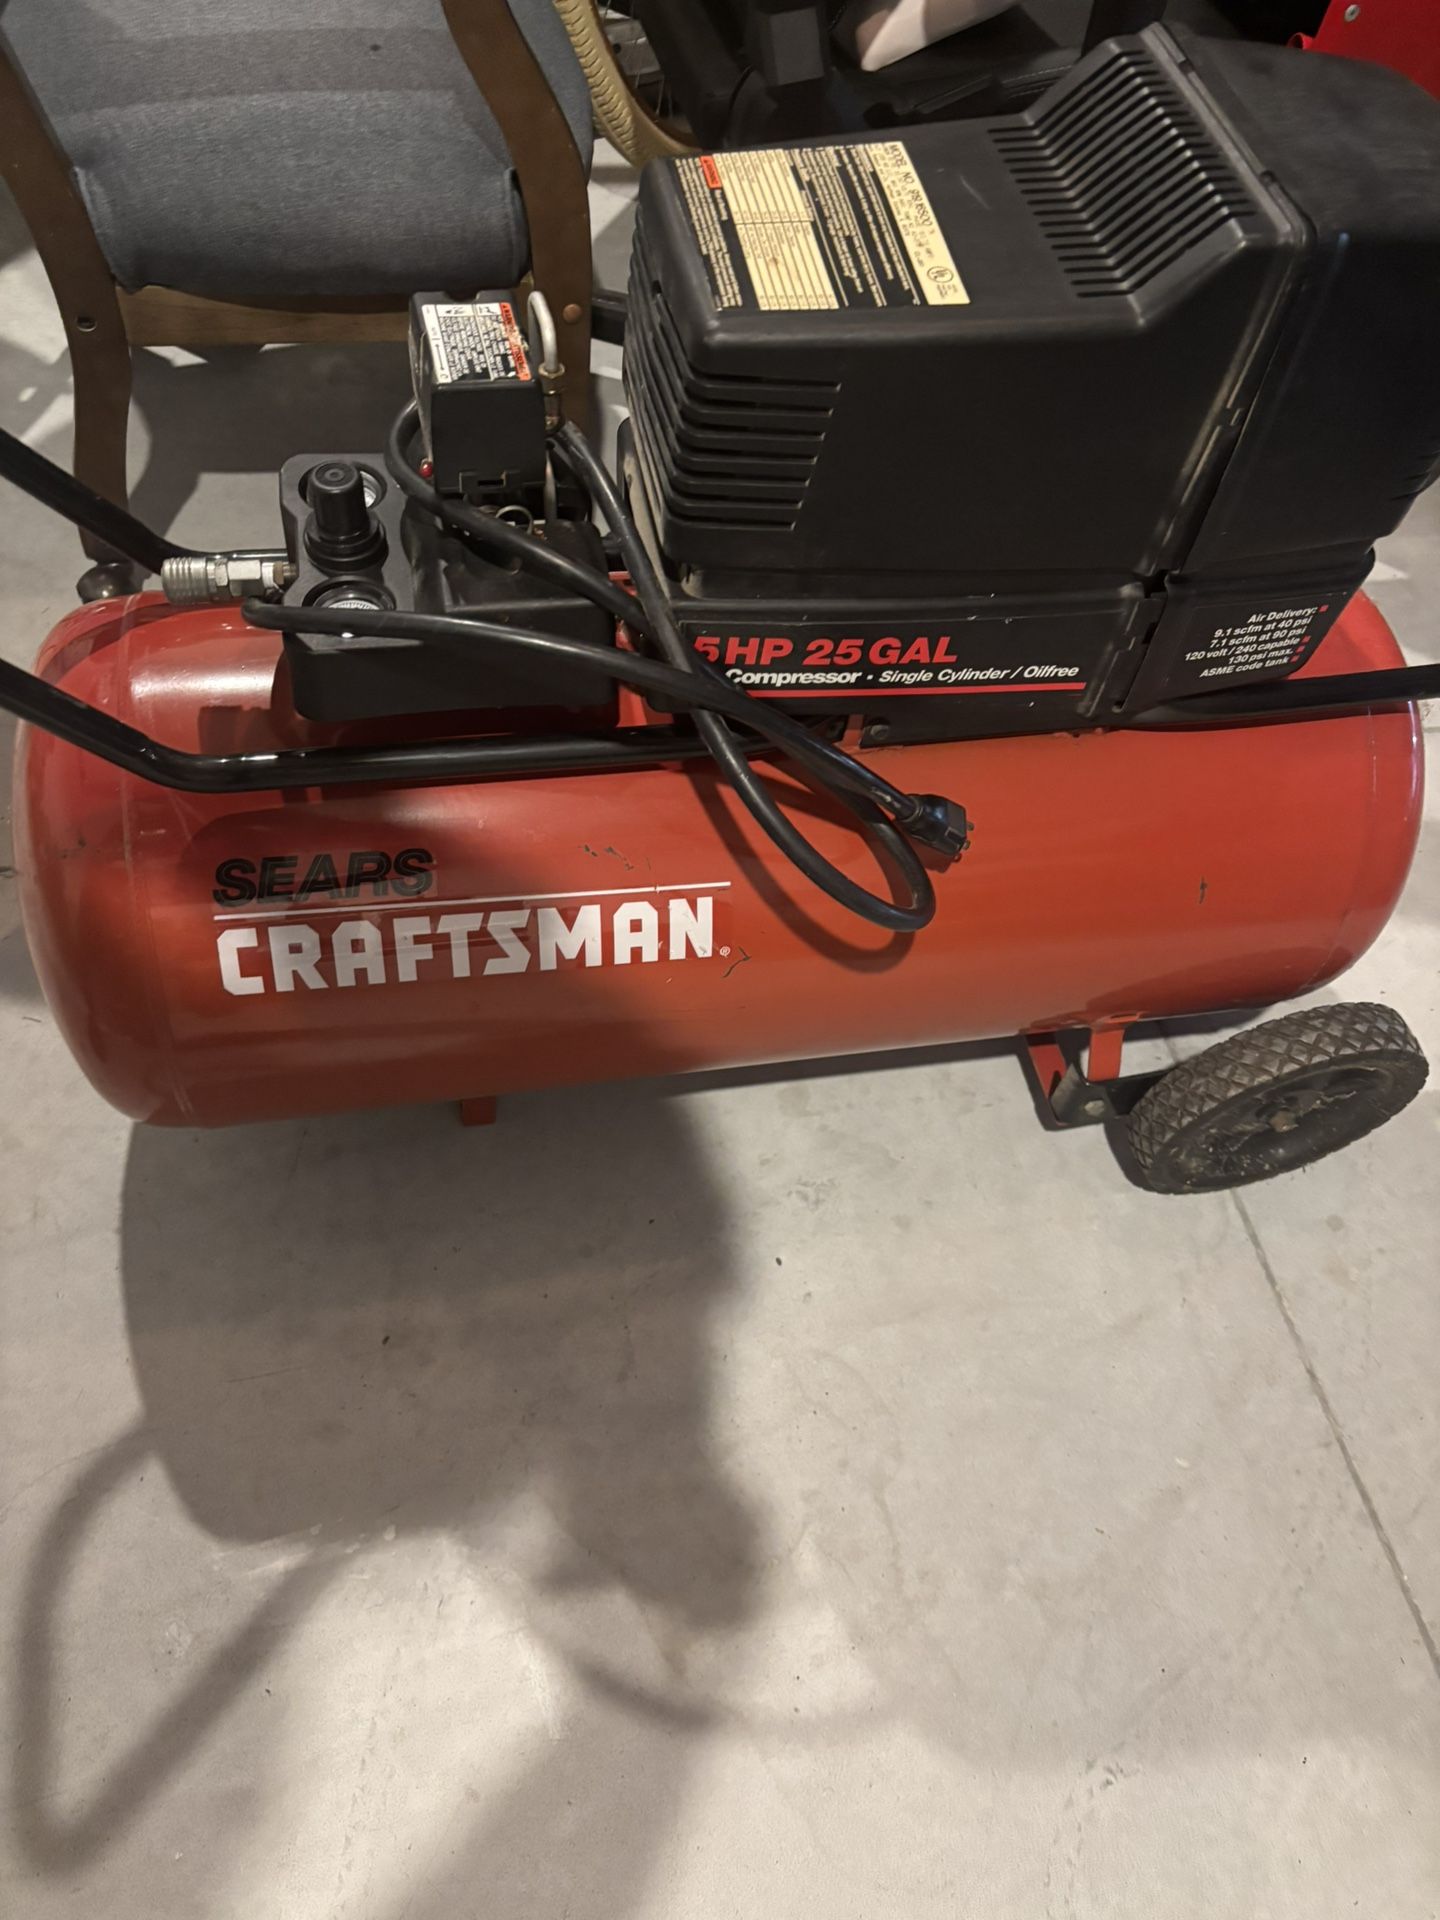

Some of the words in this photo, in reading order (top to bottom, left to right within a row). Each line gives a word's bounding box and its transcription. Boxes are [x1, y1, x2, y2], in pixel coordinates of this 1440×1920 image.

[1247, 615, 1267, 623] Air
[1267, 607, 1317, 620] Delivery:
[1209, 638, 1227, 649] 7.1
[1228, 636, 1256, 646] scfm
[1258, 634, 1271, 642] at
[1272, 630, 1287, 639] 90
[1287, 626, 1307, 638] psi
[1214, 629, 1231, 638] 9.1
[1234, 626, 1262, 636] scfm
[1277, 620, 1292, 629] 40
[1293, 617, 1313, 627] psi
[694, 636, 721, 662] 5
[725, 636, 794, 666] HP
[801, 638, 866, 667] 25
[868, 636, 958, 666] GAL
[1184, 651, 1205, 661] 120
[1206, 647, 1229, 658] volt
[1235, 644, 1256, 654] 240
[1257, 638, 1300, 651] capable
[1228, 655, 1248, 665] 130
[1248, 651, 1268, 663] psi
[1267, 648, 1293, 659] max.
[725, 668, 862, 687] Compressor
[878, 670, 934, 684] Single
[937, 668, 1012, 682] Cylinder
[1023, 665, 1080, 679] Oilfree
[1199, 666, 1234, 677] ASME
[1235, 661, 1262, 672] code
[1264, 657, 1289, 667] tank
[212, 848, 434, 906] SEARS
[216, 896, 713, 996] CRAFTSMAN
